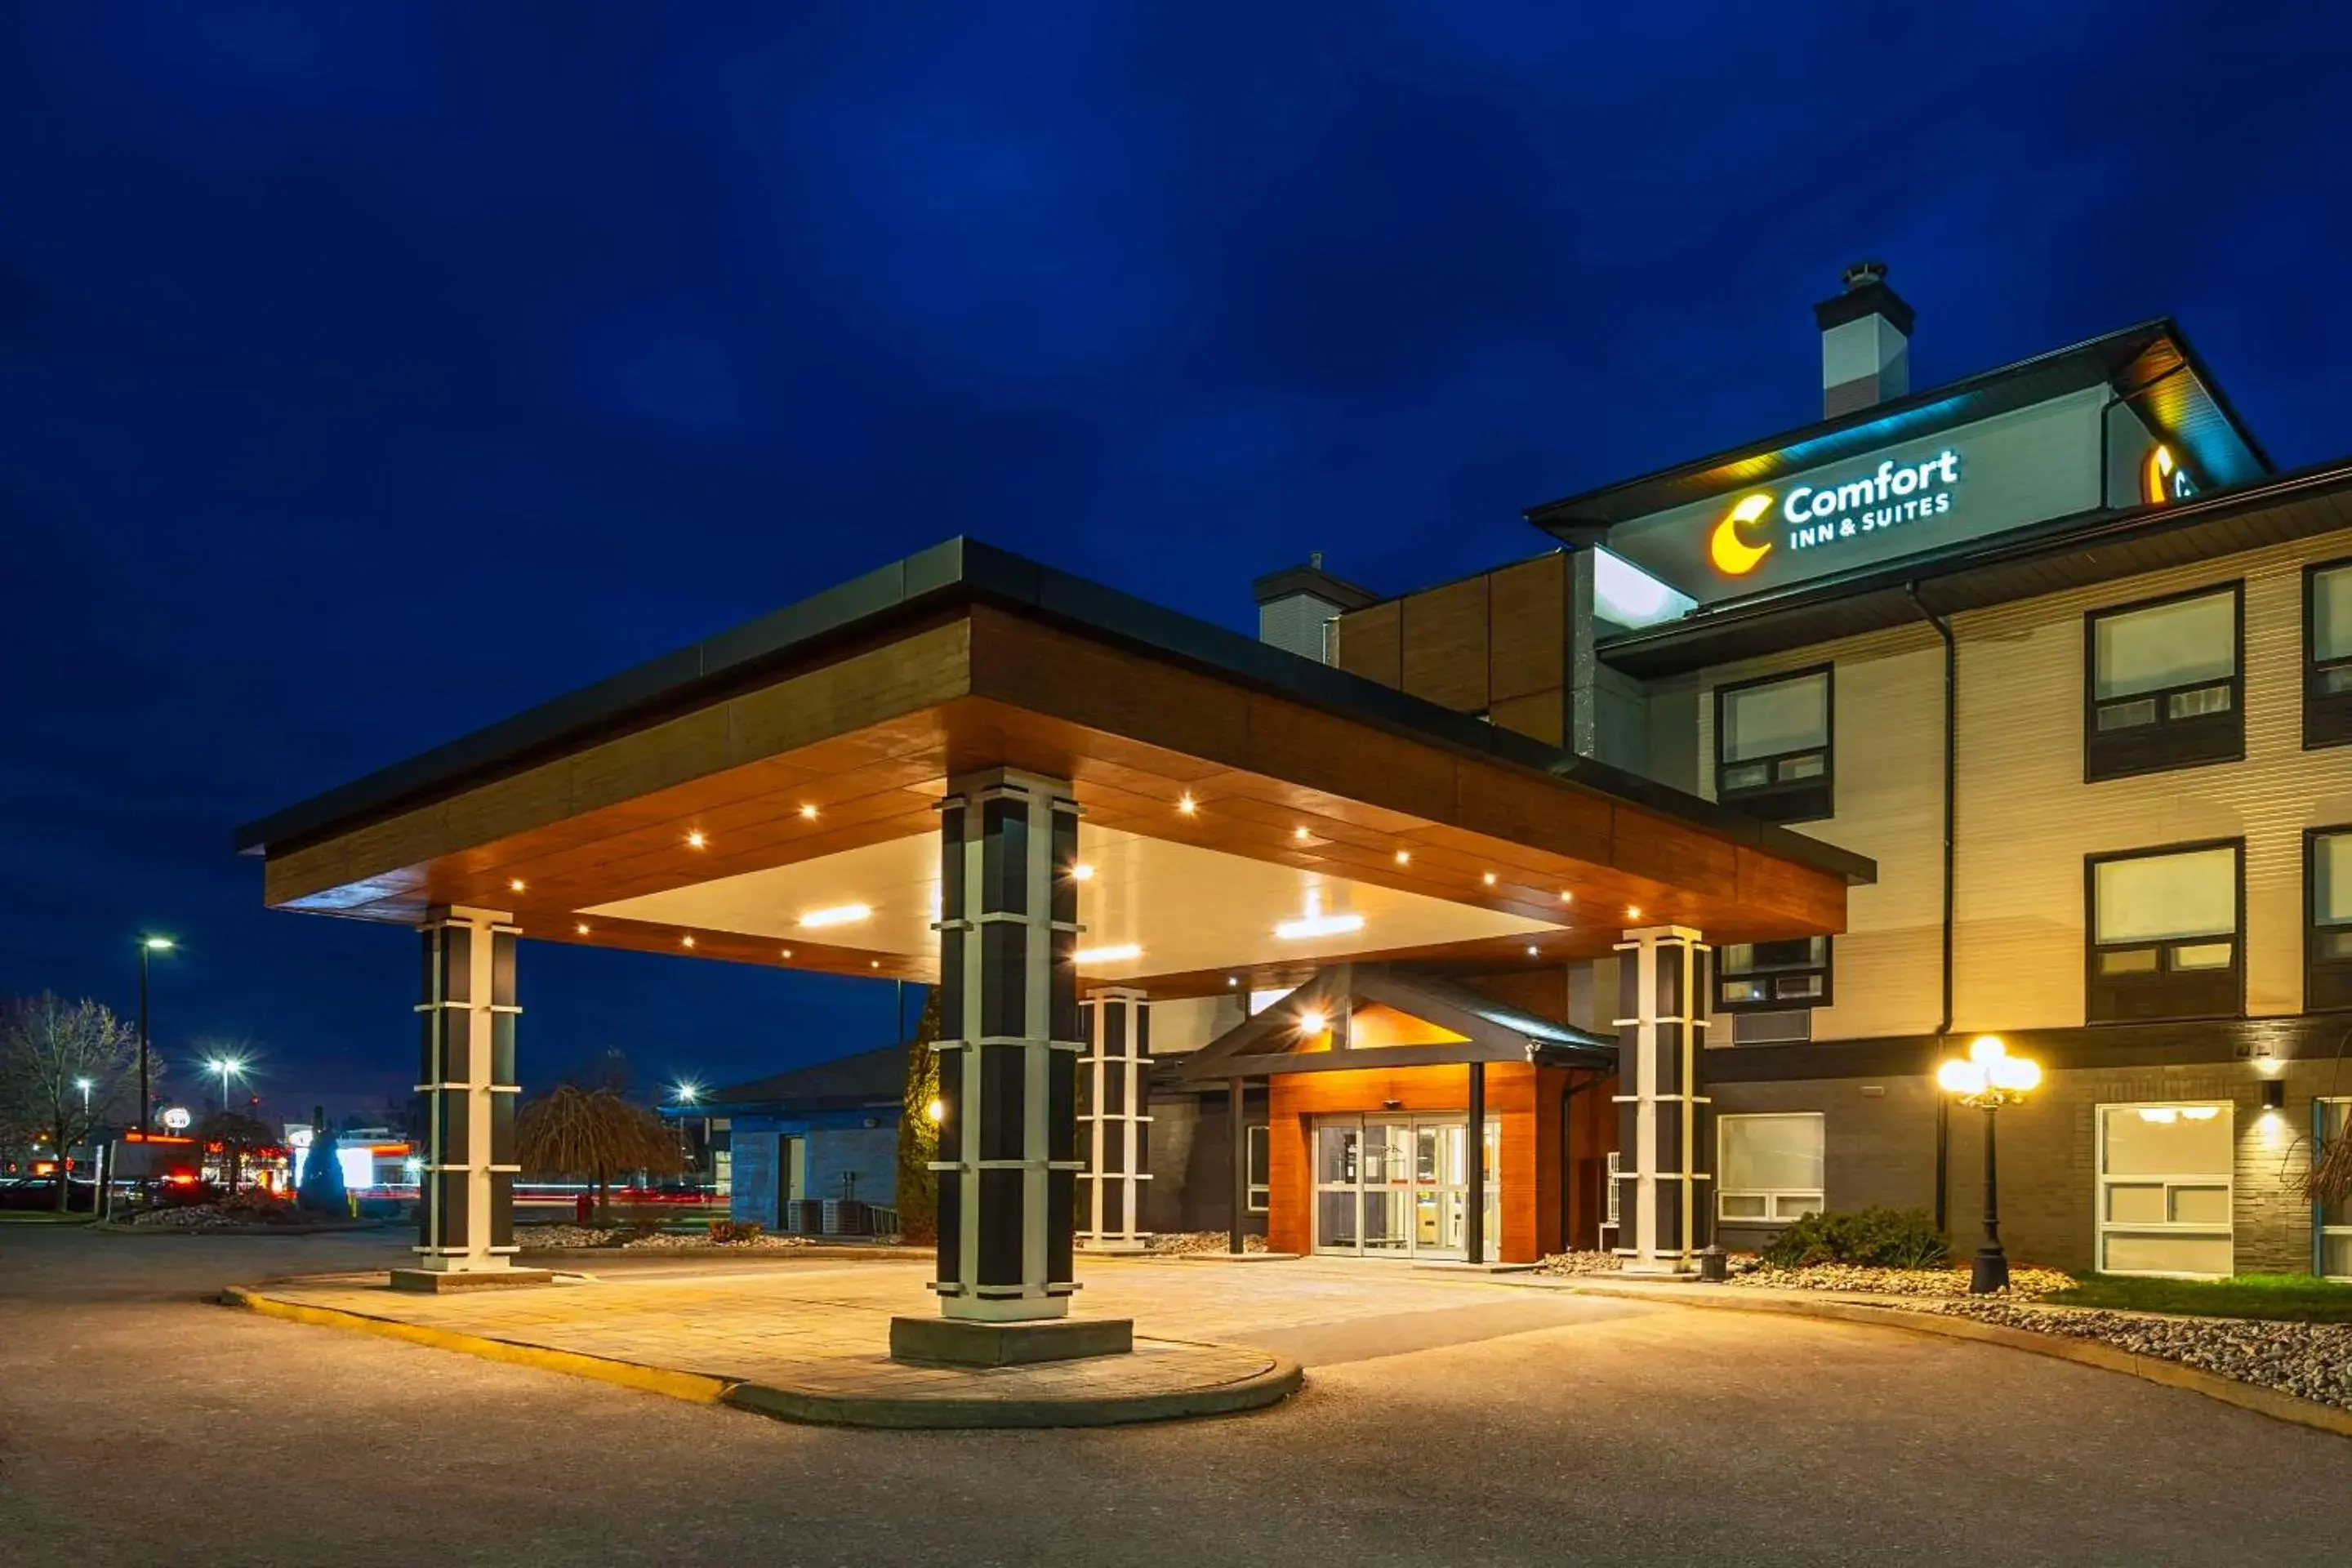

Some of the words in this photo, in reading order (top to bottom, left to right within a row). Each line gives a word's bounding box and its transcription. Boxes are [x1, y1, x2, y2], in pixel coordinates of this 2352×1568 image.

[1784, 451, 1958, 523] Comfort
[1790, 523, 1833, 550] INN
[1839, 518, 1856, 536] &
[1862, 492, 1949, 530] SUITES
